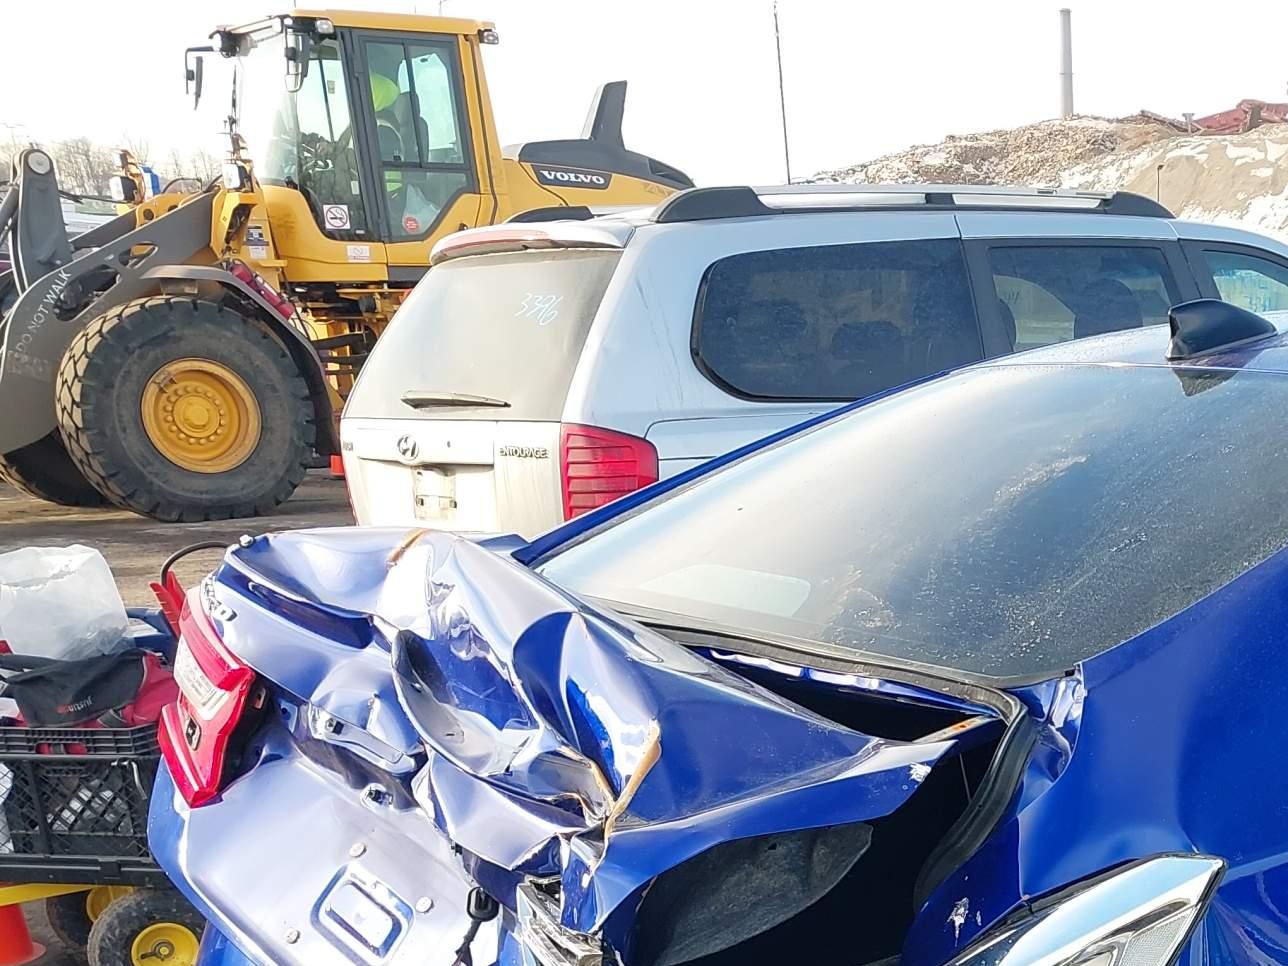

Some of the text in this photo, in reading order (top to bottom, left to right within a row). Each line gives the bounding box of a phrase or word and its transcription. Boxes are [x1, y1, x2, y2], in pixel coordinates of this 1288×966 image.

[540, 170, 605, 185] VOLVO
[16, 333, 33, 353] DO
[27, 304, 49, 334] NOT
[43, 268, 72, 304] WALK
[499, 445, 549, 459] ENTOURAGE
